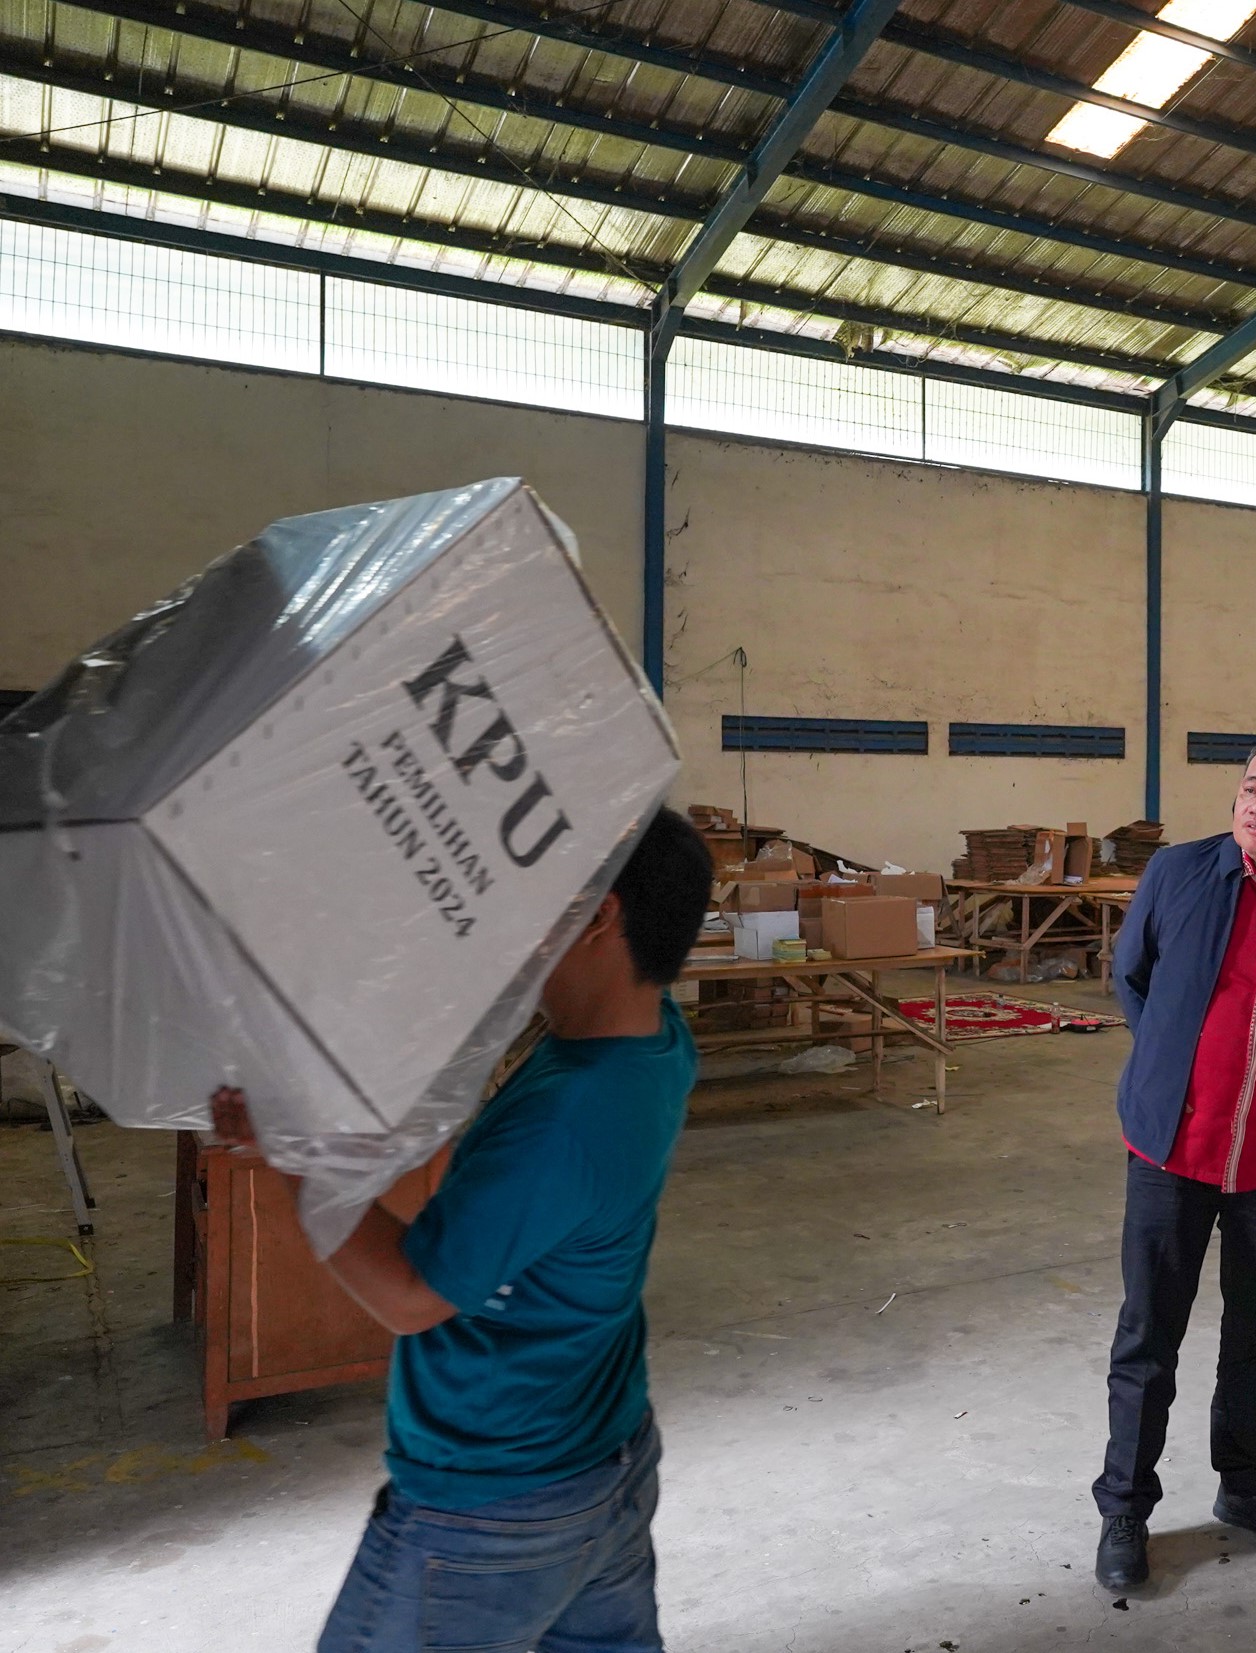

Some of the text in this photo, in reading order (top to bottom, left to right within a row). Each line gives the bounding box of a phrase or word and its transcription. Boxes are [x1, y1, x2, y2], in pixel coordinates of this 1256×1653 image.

[341, 742, 477, 938] TAHUN 2024
[381, 730, 495, 896] PEMILIHAN
[402, 635, 573, 867] KPU
